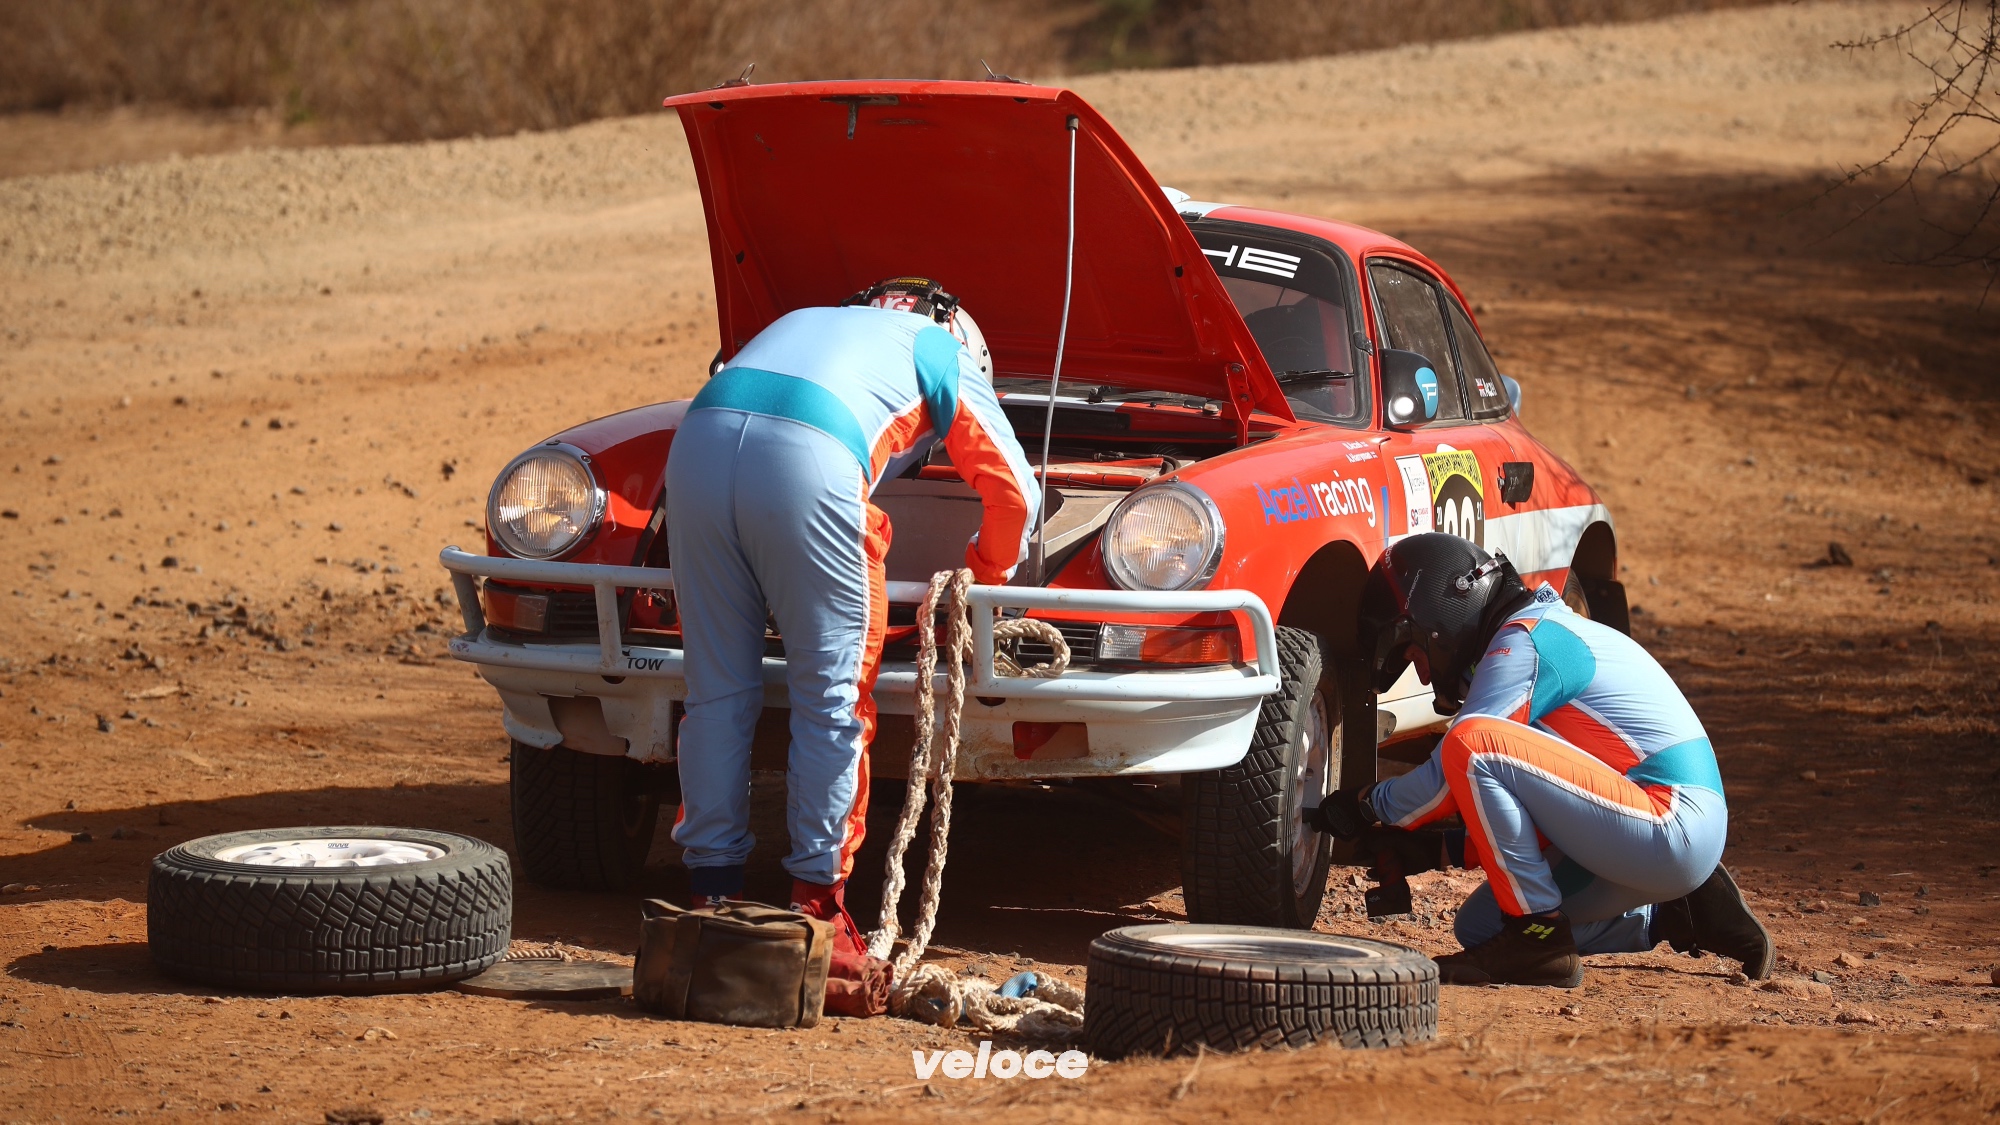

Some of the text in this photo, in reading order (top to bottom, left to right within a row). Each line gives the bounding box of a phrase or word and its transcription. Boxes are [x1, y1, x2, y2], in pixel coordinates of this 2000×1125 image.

[1311, 469, 1376, 528] racing
[1538, 590, 1552, 603] FIA
[627, 657, 665, 671] TOW
